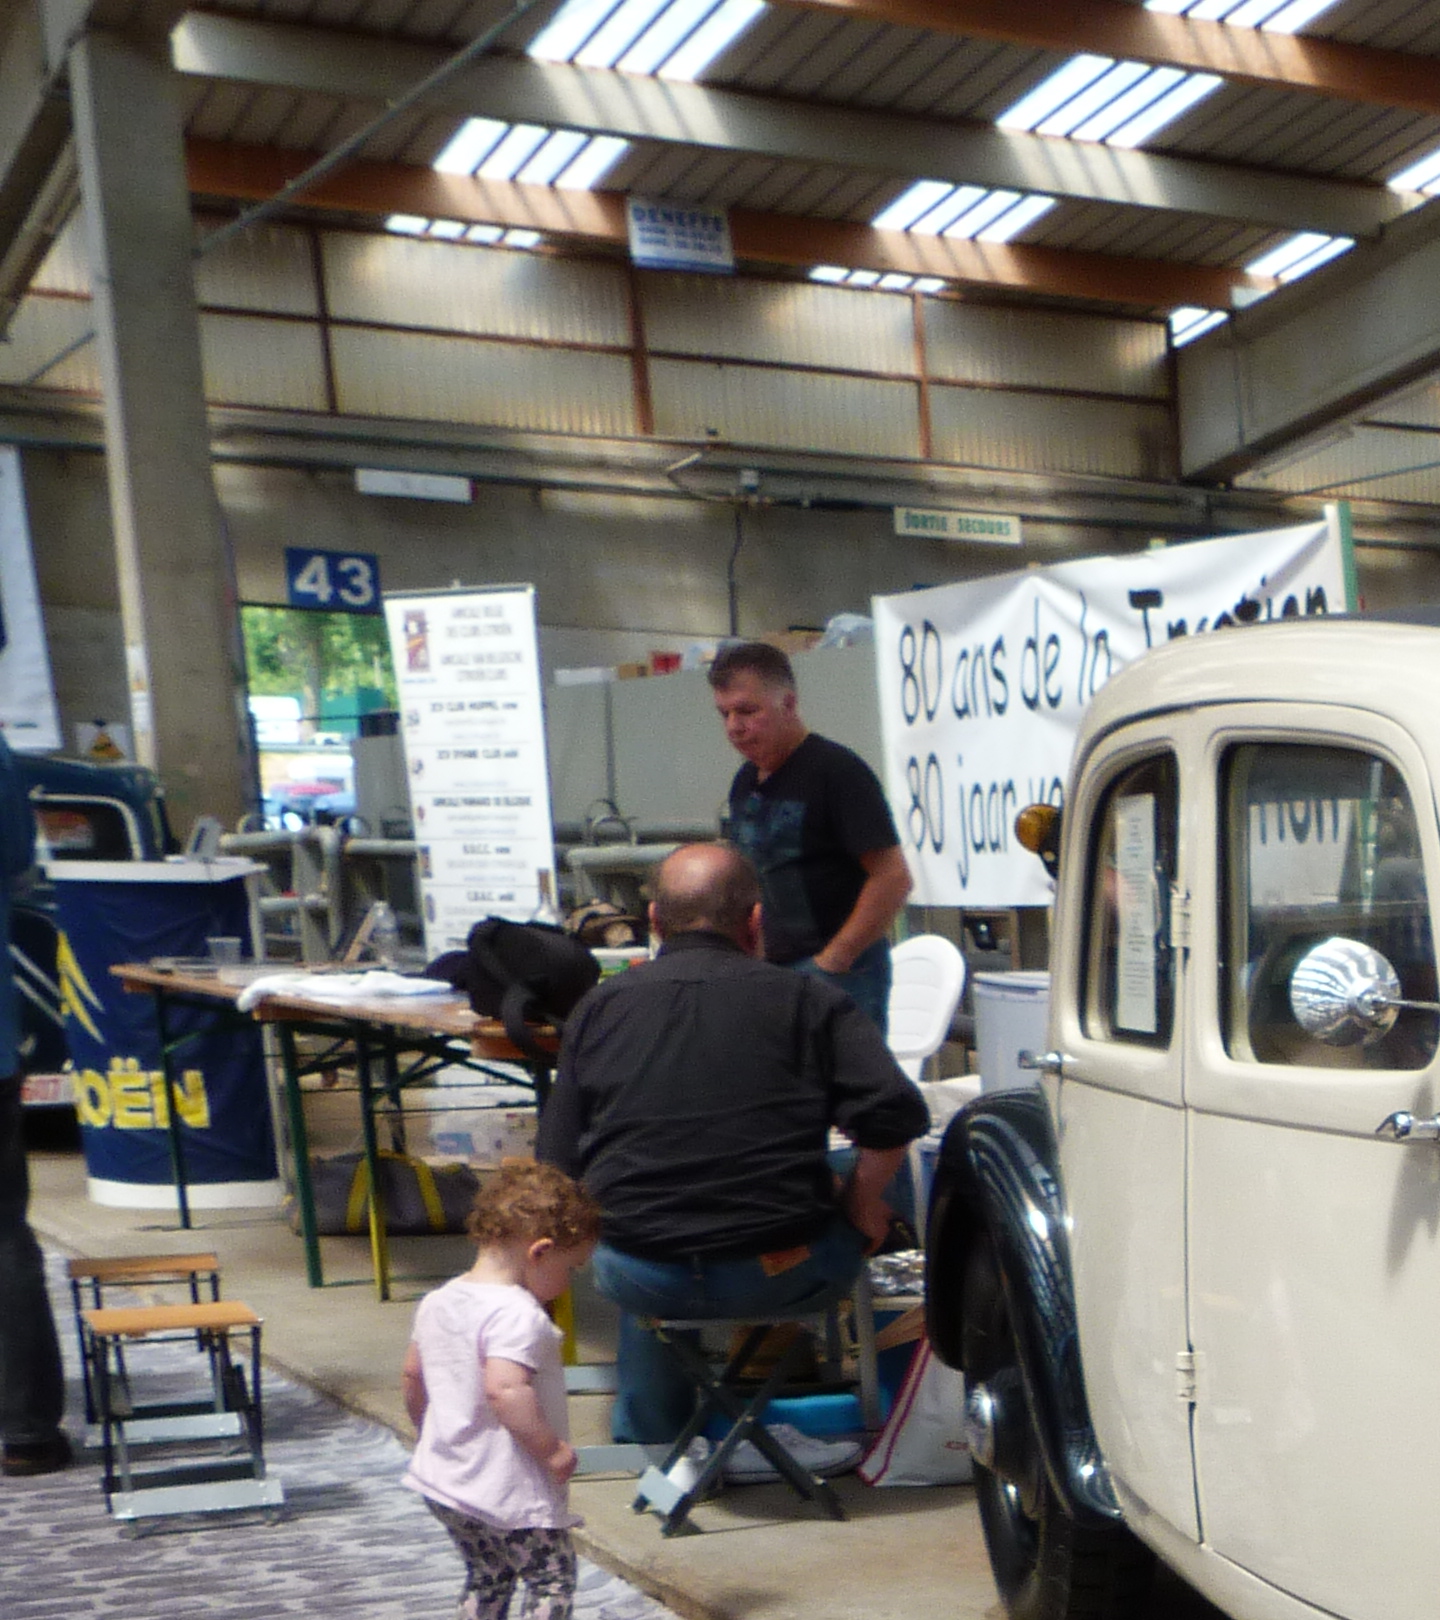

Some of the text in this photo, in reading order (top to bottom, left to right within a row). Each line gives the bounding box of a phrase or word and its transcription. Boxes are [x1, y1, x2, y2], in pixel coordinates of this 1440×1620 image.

[294, 555, 374, 605] 43
[900, 617, 944, 726] 80
[951, 634, 1010, 721] ans
[1020, 595, 1064, 712] de
[1077, 590, 1113, 707] la
[907, 753, 1016, 890] 80 jaar
